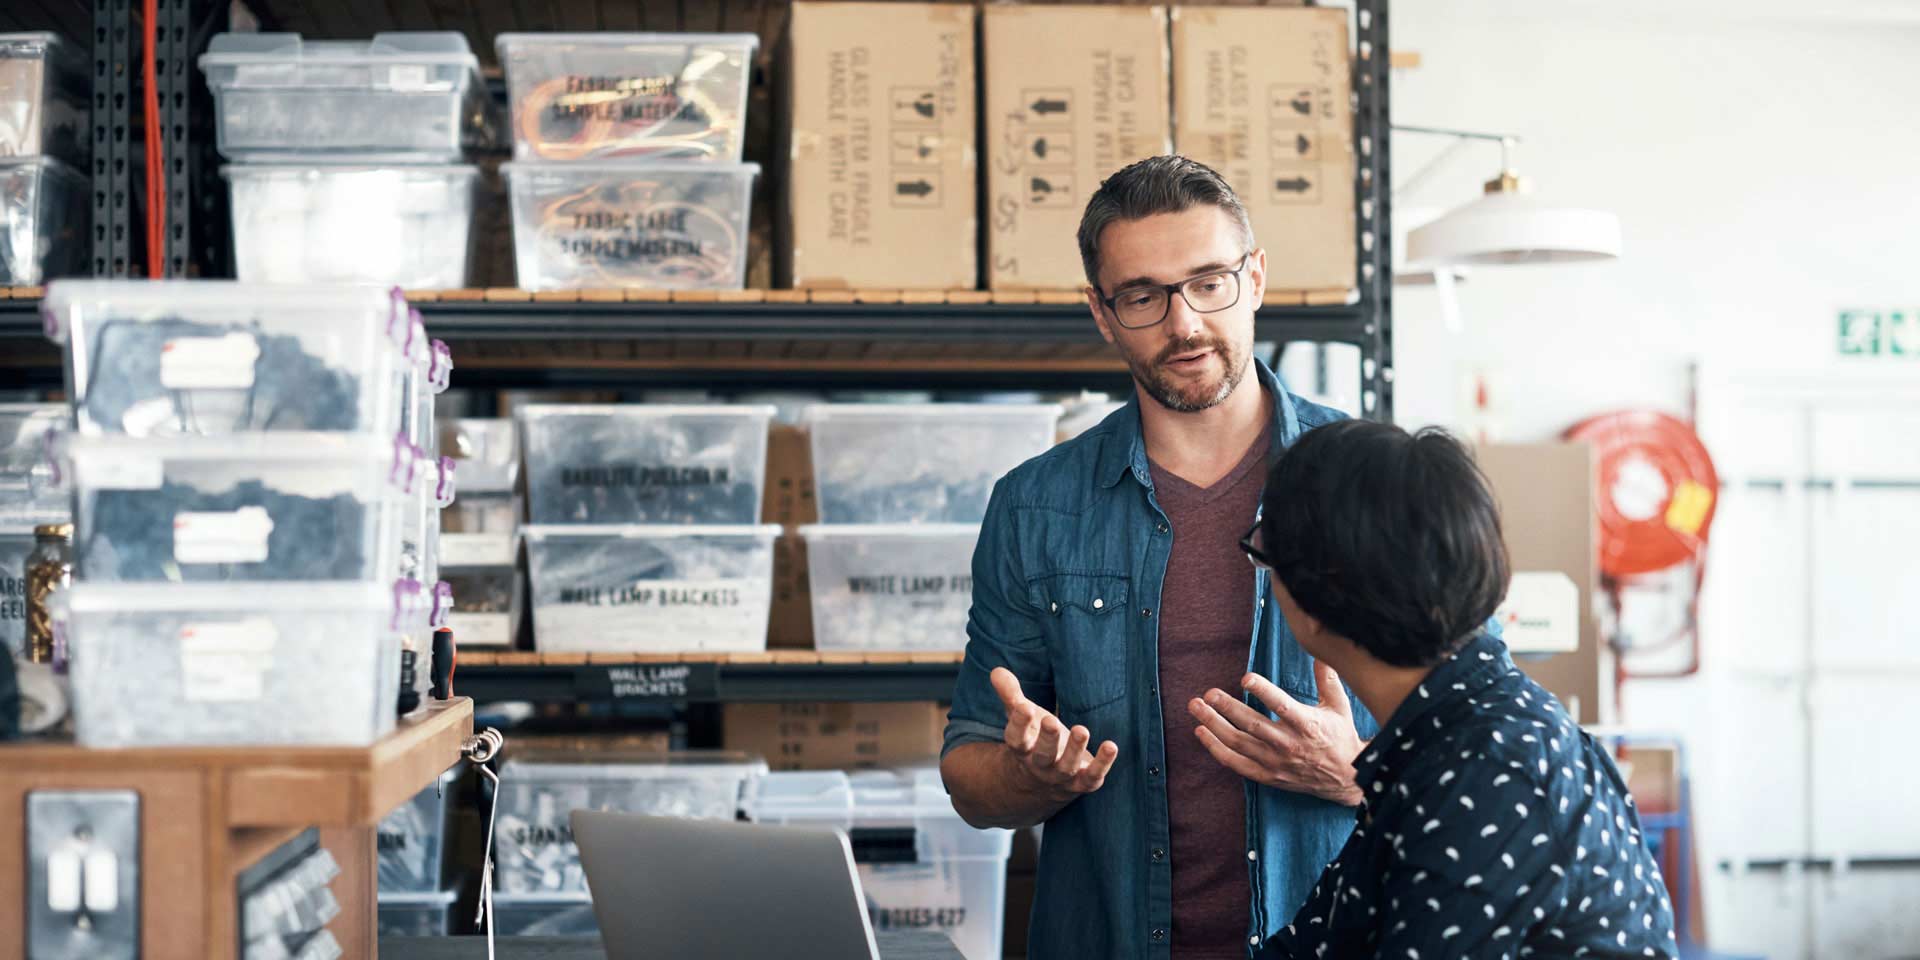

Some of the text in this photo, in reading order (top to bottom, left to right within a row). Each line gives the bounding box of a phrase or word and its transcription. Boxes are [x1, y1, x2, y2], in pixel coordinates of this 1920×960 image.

[1092, 50, 1112, 121] FRAGILE
[1206, 51, 1225, 120] HANDLE
[1230, 46, 1248, 106] GLASS
[1116, 55, 1135, 158] WITH CARE
[829, 52, 848, 239] HANDLE WITH CARE
[851, 47, 871, 246] GLASS ITEM FRAGILE
[1232, 115, 1249, 159] ITEM
[560, 588, 739, 606] WALL LAMP BRACKETS
[847, 576, 895, 595] WHITE
[902, 576, 945, 595] LAMP
[608, 666, 689, 682] WALL LAMP
[613, 681, 687, 696] BRACKETS
